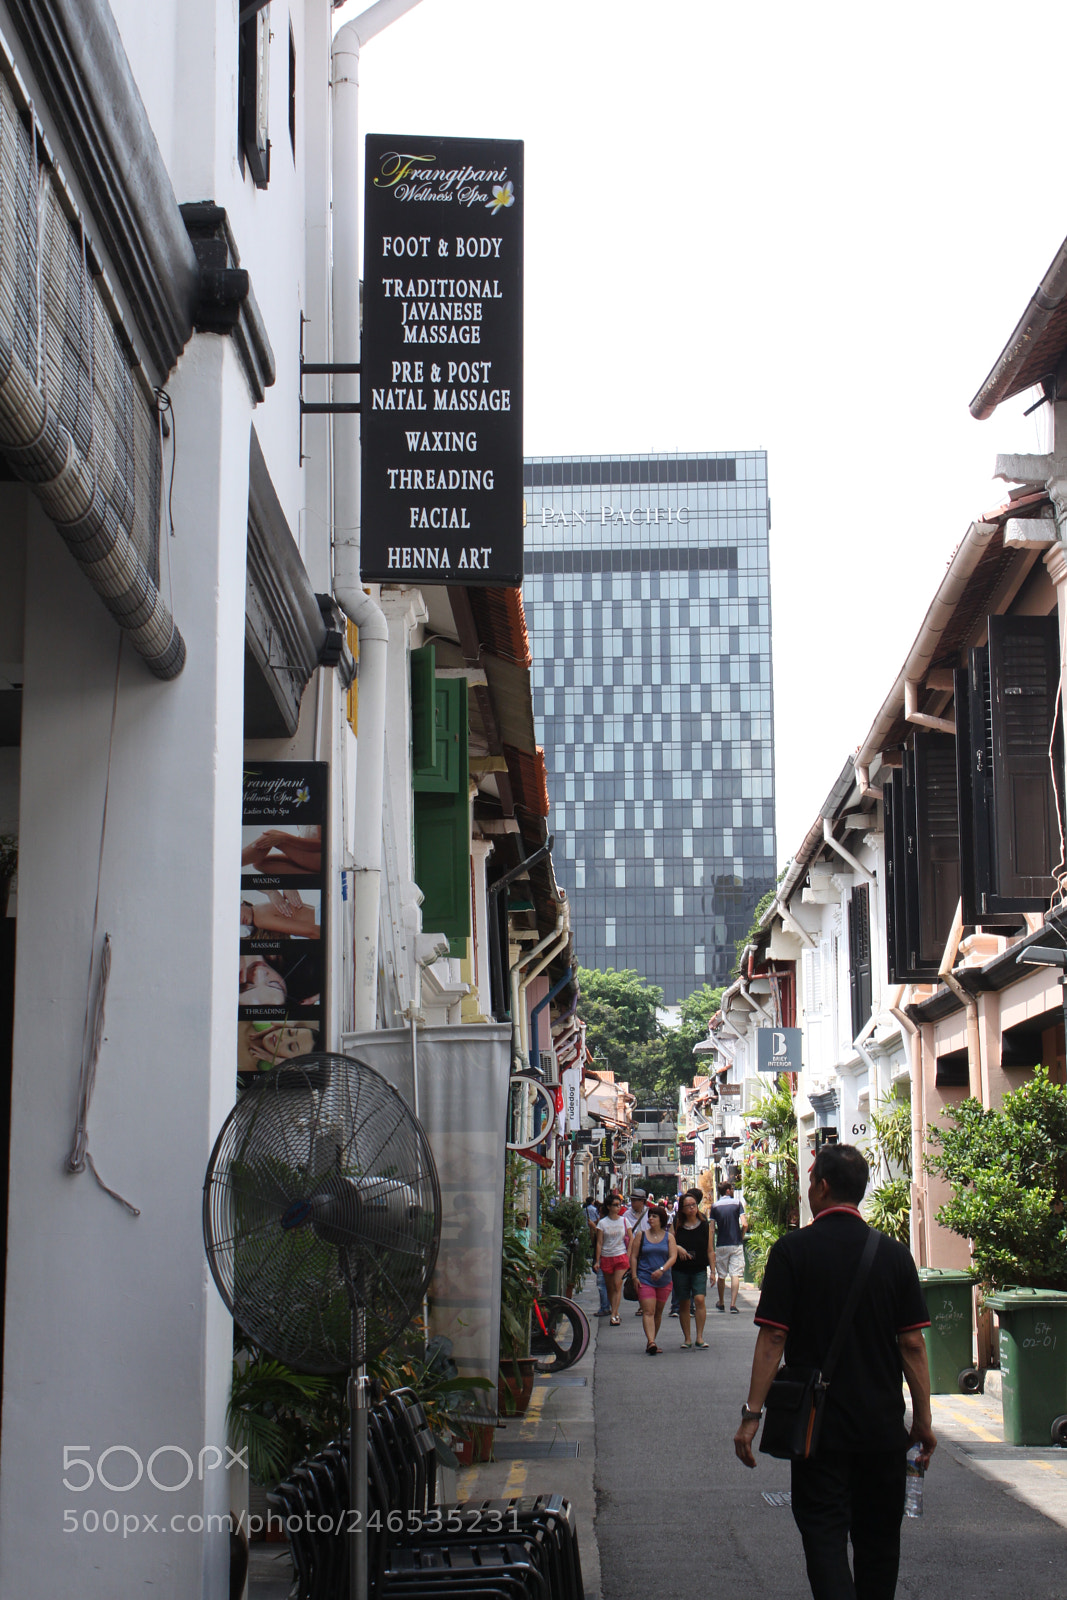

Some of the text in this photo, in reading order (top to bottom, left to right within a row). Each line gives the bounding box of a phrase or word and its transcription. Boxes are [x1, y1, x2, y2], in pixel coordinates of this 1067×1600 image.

[374, 152, 507, 191] Frangipani
[394, 182, 489, 207] Wellness Spa
[382, 236, 503, 258] FOOT & BODY
[382, 278, 503, 299] TRADITIONAL
[401, 302, 483, 325] JAVANESE
[403, 325, 481, 344] MASSAGE
[392, 361, 492, 383] PRE & POST
[371, 388, 511, 411] NATAL MASSAGE
[405, 431, 478, 452] WAXING
[387, 468, 495, 490] THREADING
[409, 507, 471, 529] FACIAL
[540, 505, 691, 528] PAN PACIFIC
[387, 547, 492, 569] HENNA ART
[852, 1123, 867, 1135] 69
